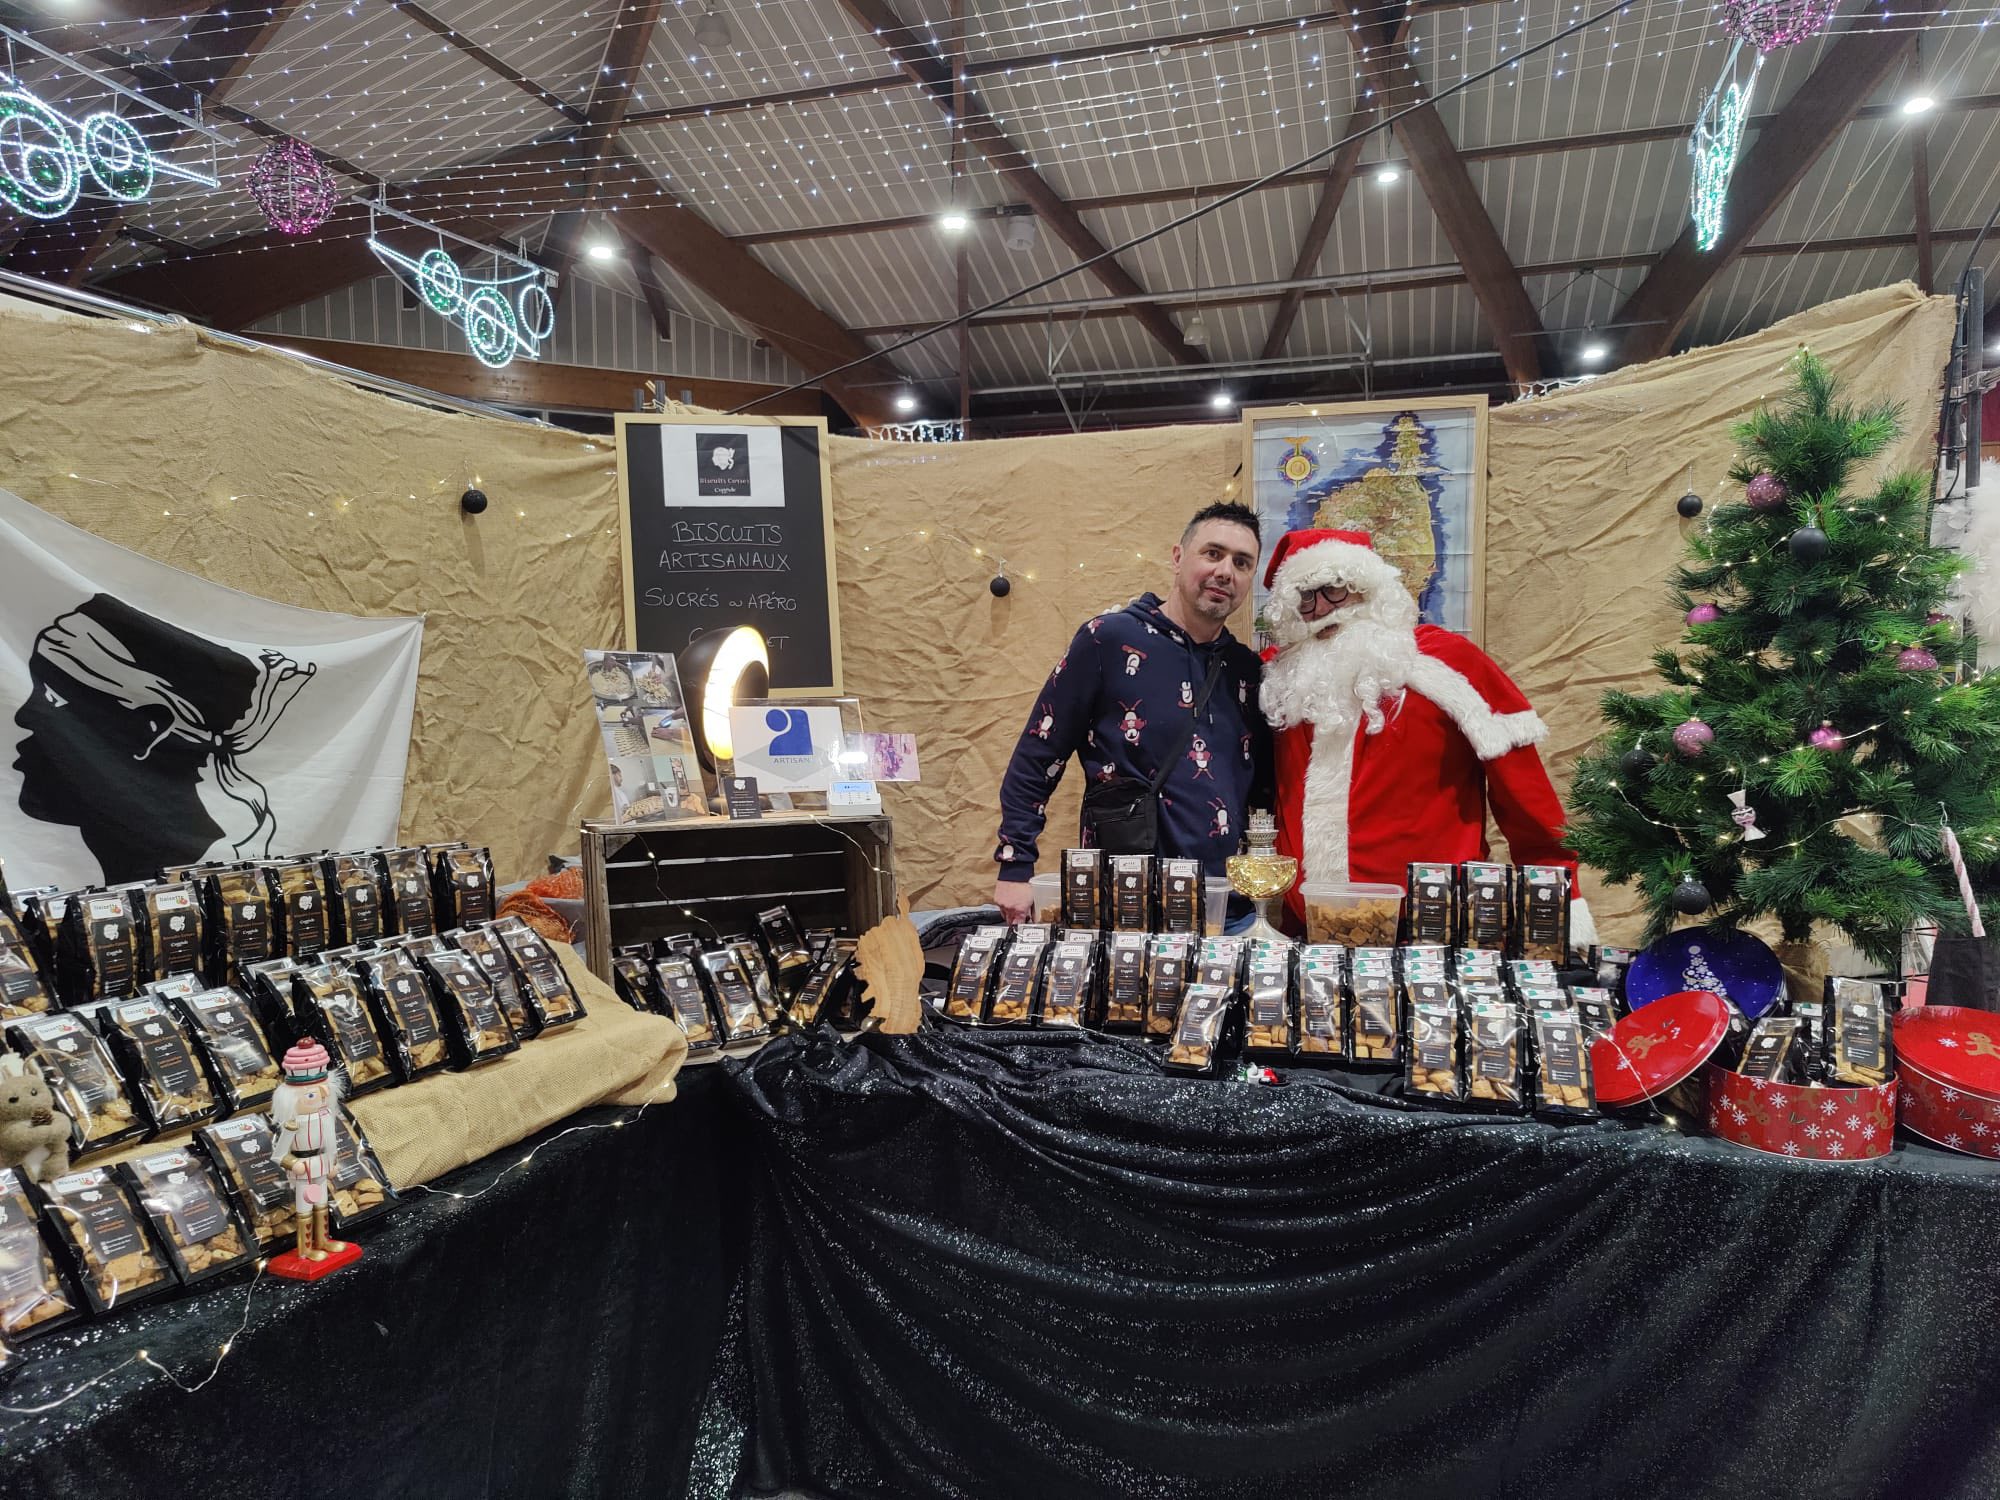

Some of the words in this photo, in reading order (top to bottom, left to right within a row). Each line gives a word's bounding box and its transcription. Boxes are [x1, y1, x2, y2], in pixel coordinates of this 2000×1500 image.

[671, 520, 783, 544] BISCUITS
[658, 550, 791, 571] ARTISANAUX
[748, 590, 797, 611] APÉRO
